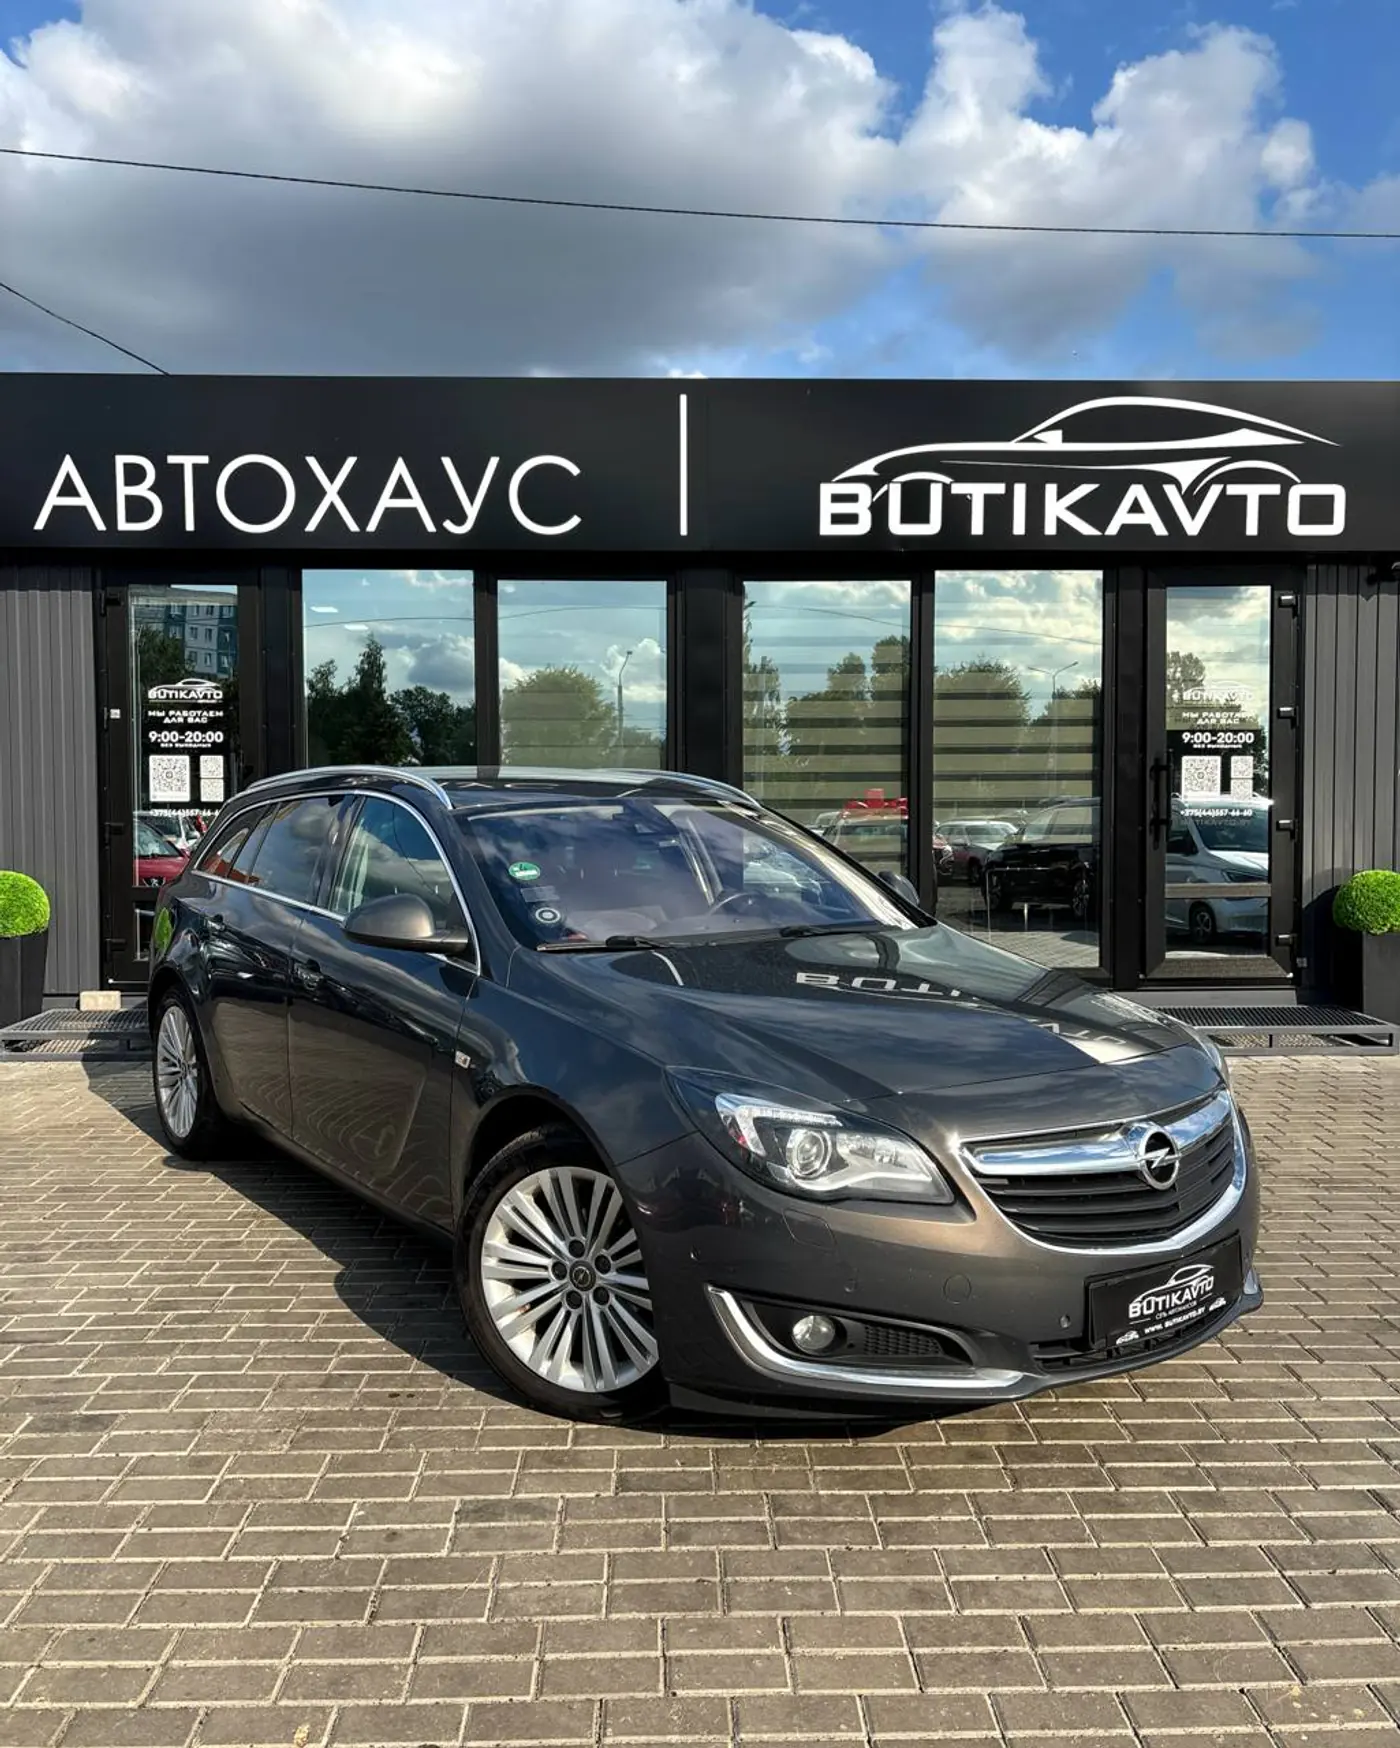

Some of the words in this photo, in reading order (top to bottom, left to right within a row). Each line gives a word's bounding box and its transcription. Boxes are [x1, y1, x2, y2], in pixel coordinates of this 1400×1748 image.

[33, 454, 582, 535] АВТОХАУС
[819, 483, 1347, 537] BUTIKAVTO
[147, 689, 223, 699] BUTIKAVTO
[148, 731, 224, 743] 9:00-20:00
[1182, 732, 1255, 743] 9:00-20:00
[1128, 1276, 1215, 1319] BUTIKAVTO
